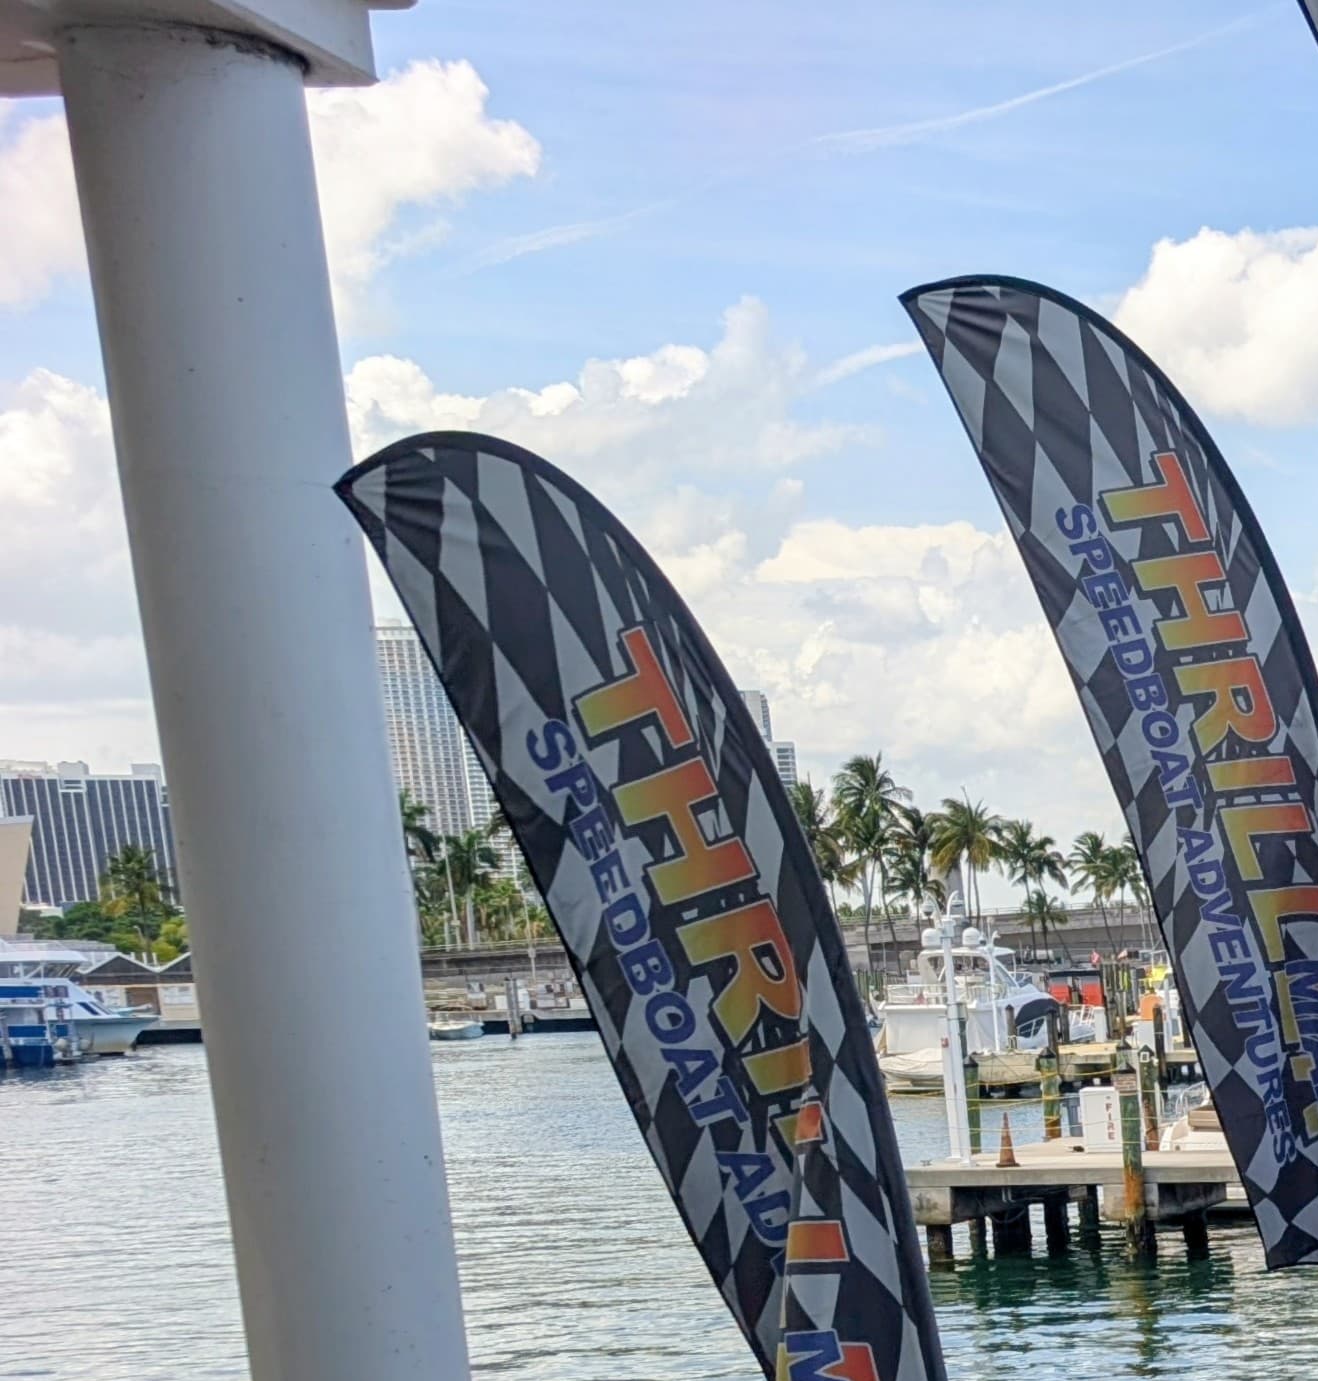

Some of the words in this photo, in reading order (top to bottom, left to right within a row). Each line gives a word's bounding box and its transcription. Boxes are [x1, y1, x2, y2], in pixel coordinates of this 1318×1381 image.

[525, 716, 749, 1128] SPEEDBOAT
[1055, 502, 1203, 811] SPEEDBOAT
[1177, 827, 1297, 1168] ADVENTURES
[1105, 1103, 1115, 1140] FIRE
